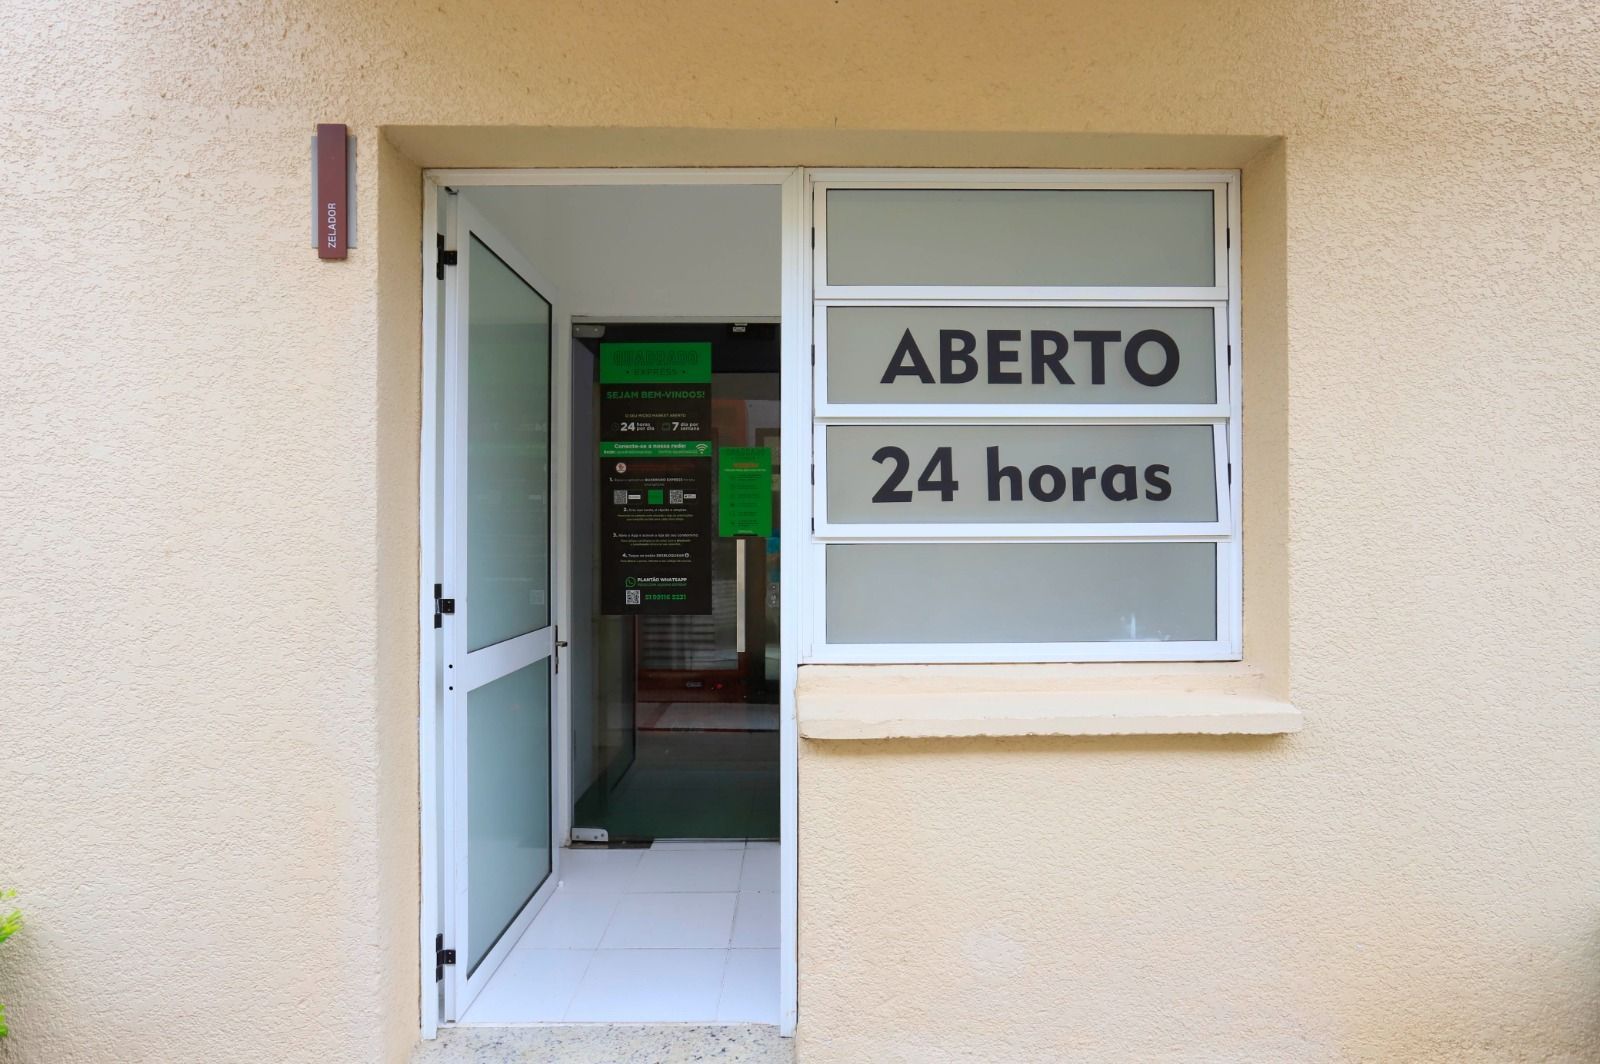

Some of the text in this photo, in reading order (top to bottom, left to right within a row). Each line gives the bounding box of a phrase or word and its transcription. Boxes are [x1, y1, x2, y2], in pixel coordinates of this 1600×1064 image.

[327, 202, 337, 249] ZELADOR
[880, 327, 1180, 387] ABERTO
[606, 390, 705, 399] SEJAM BEM-VINDOS!
[620, 422, 636, 431] 24
[671, 422, 680, 431] 7
[871, 445, 1172, 503] 24 horas
